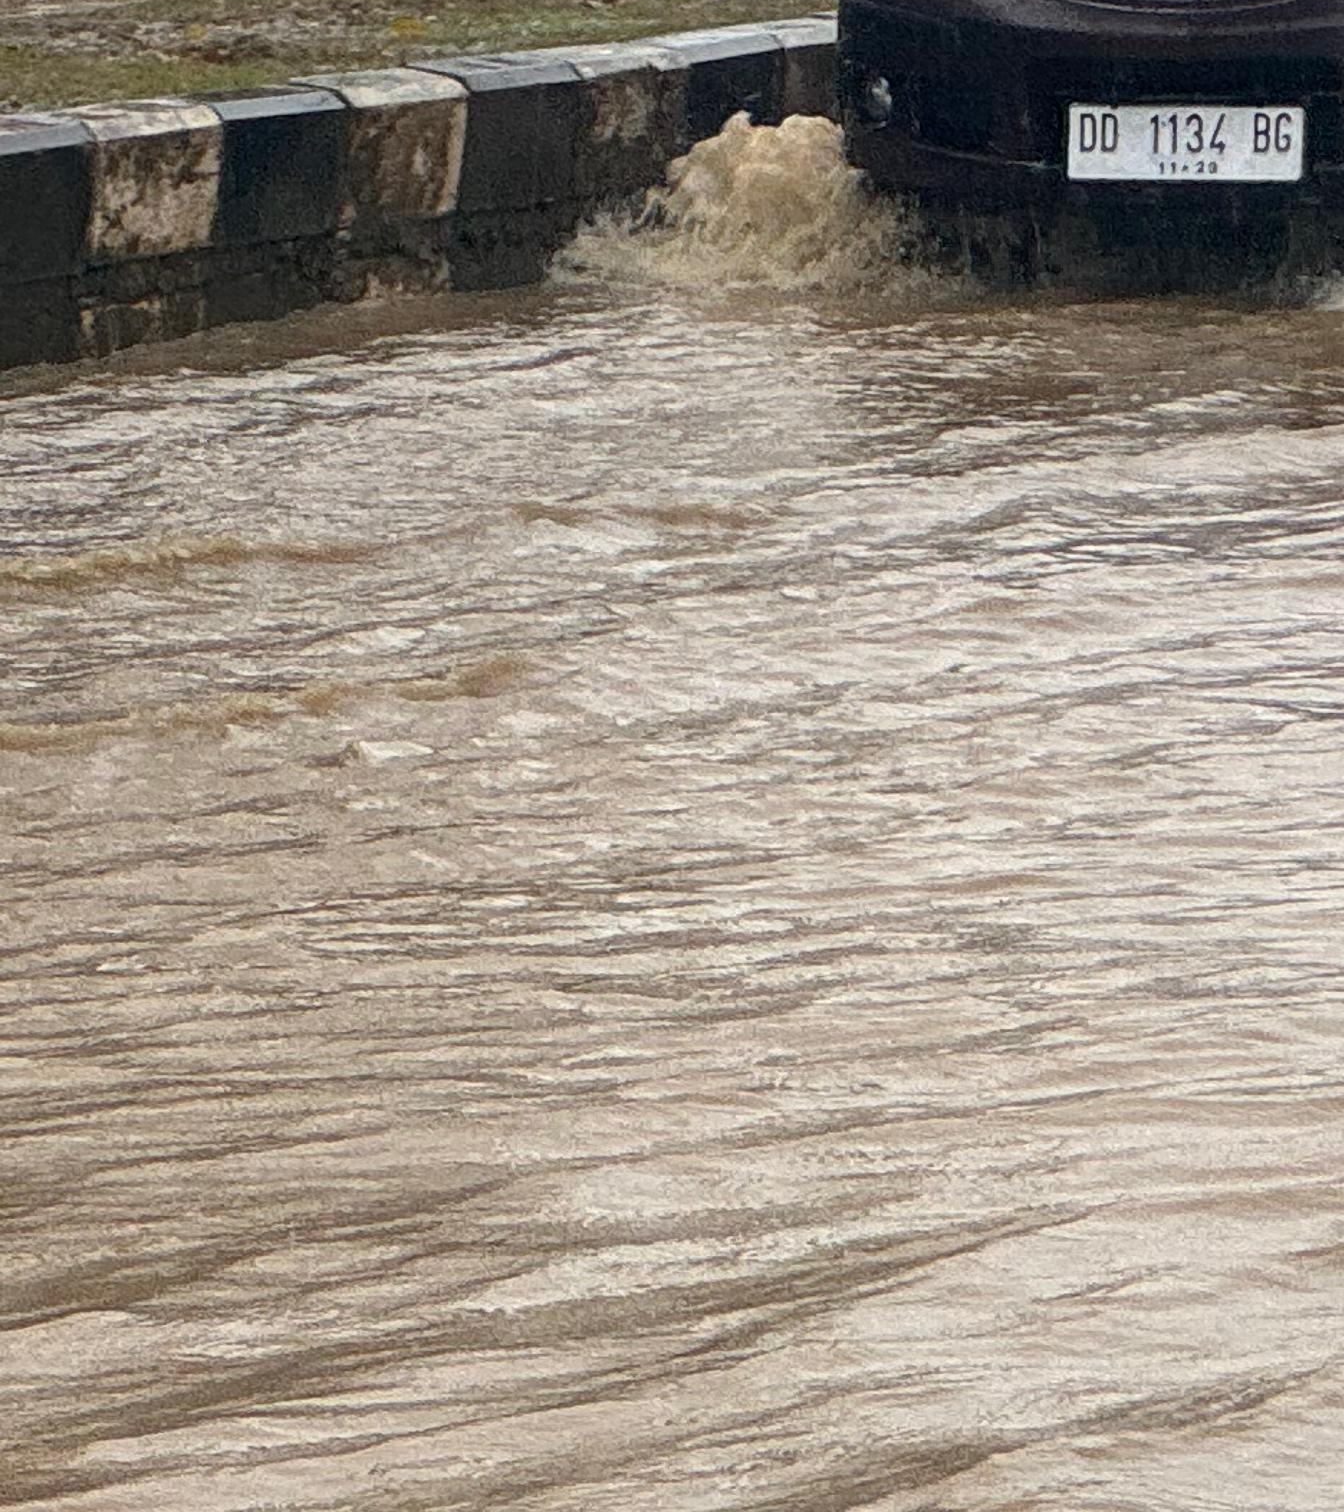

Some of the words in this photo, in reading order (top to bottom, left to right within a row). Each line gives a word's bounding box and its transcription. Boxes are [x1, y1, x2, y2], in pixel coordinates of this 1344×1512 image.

[1079, 112, 1119, 153] DD
[1150, 112, 1227, 155] 1134
[1253, 112, 1292, 154] BG
